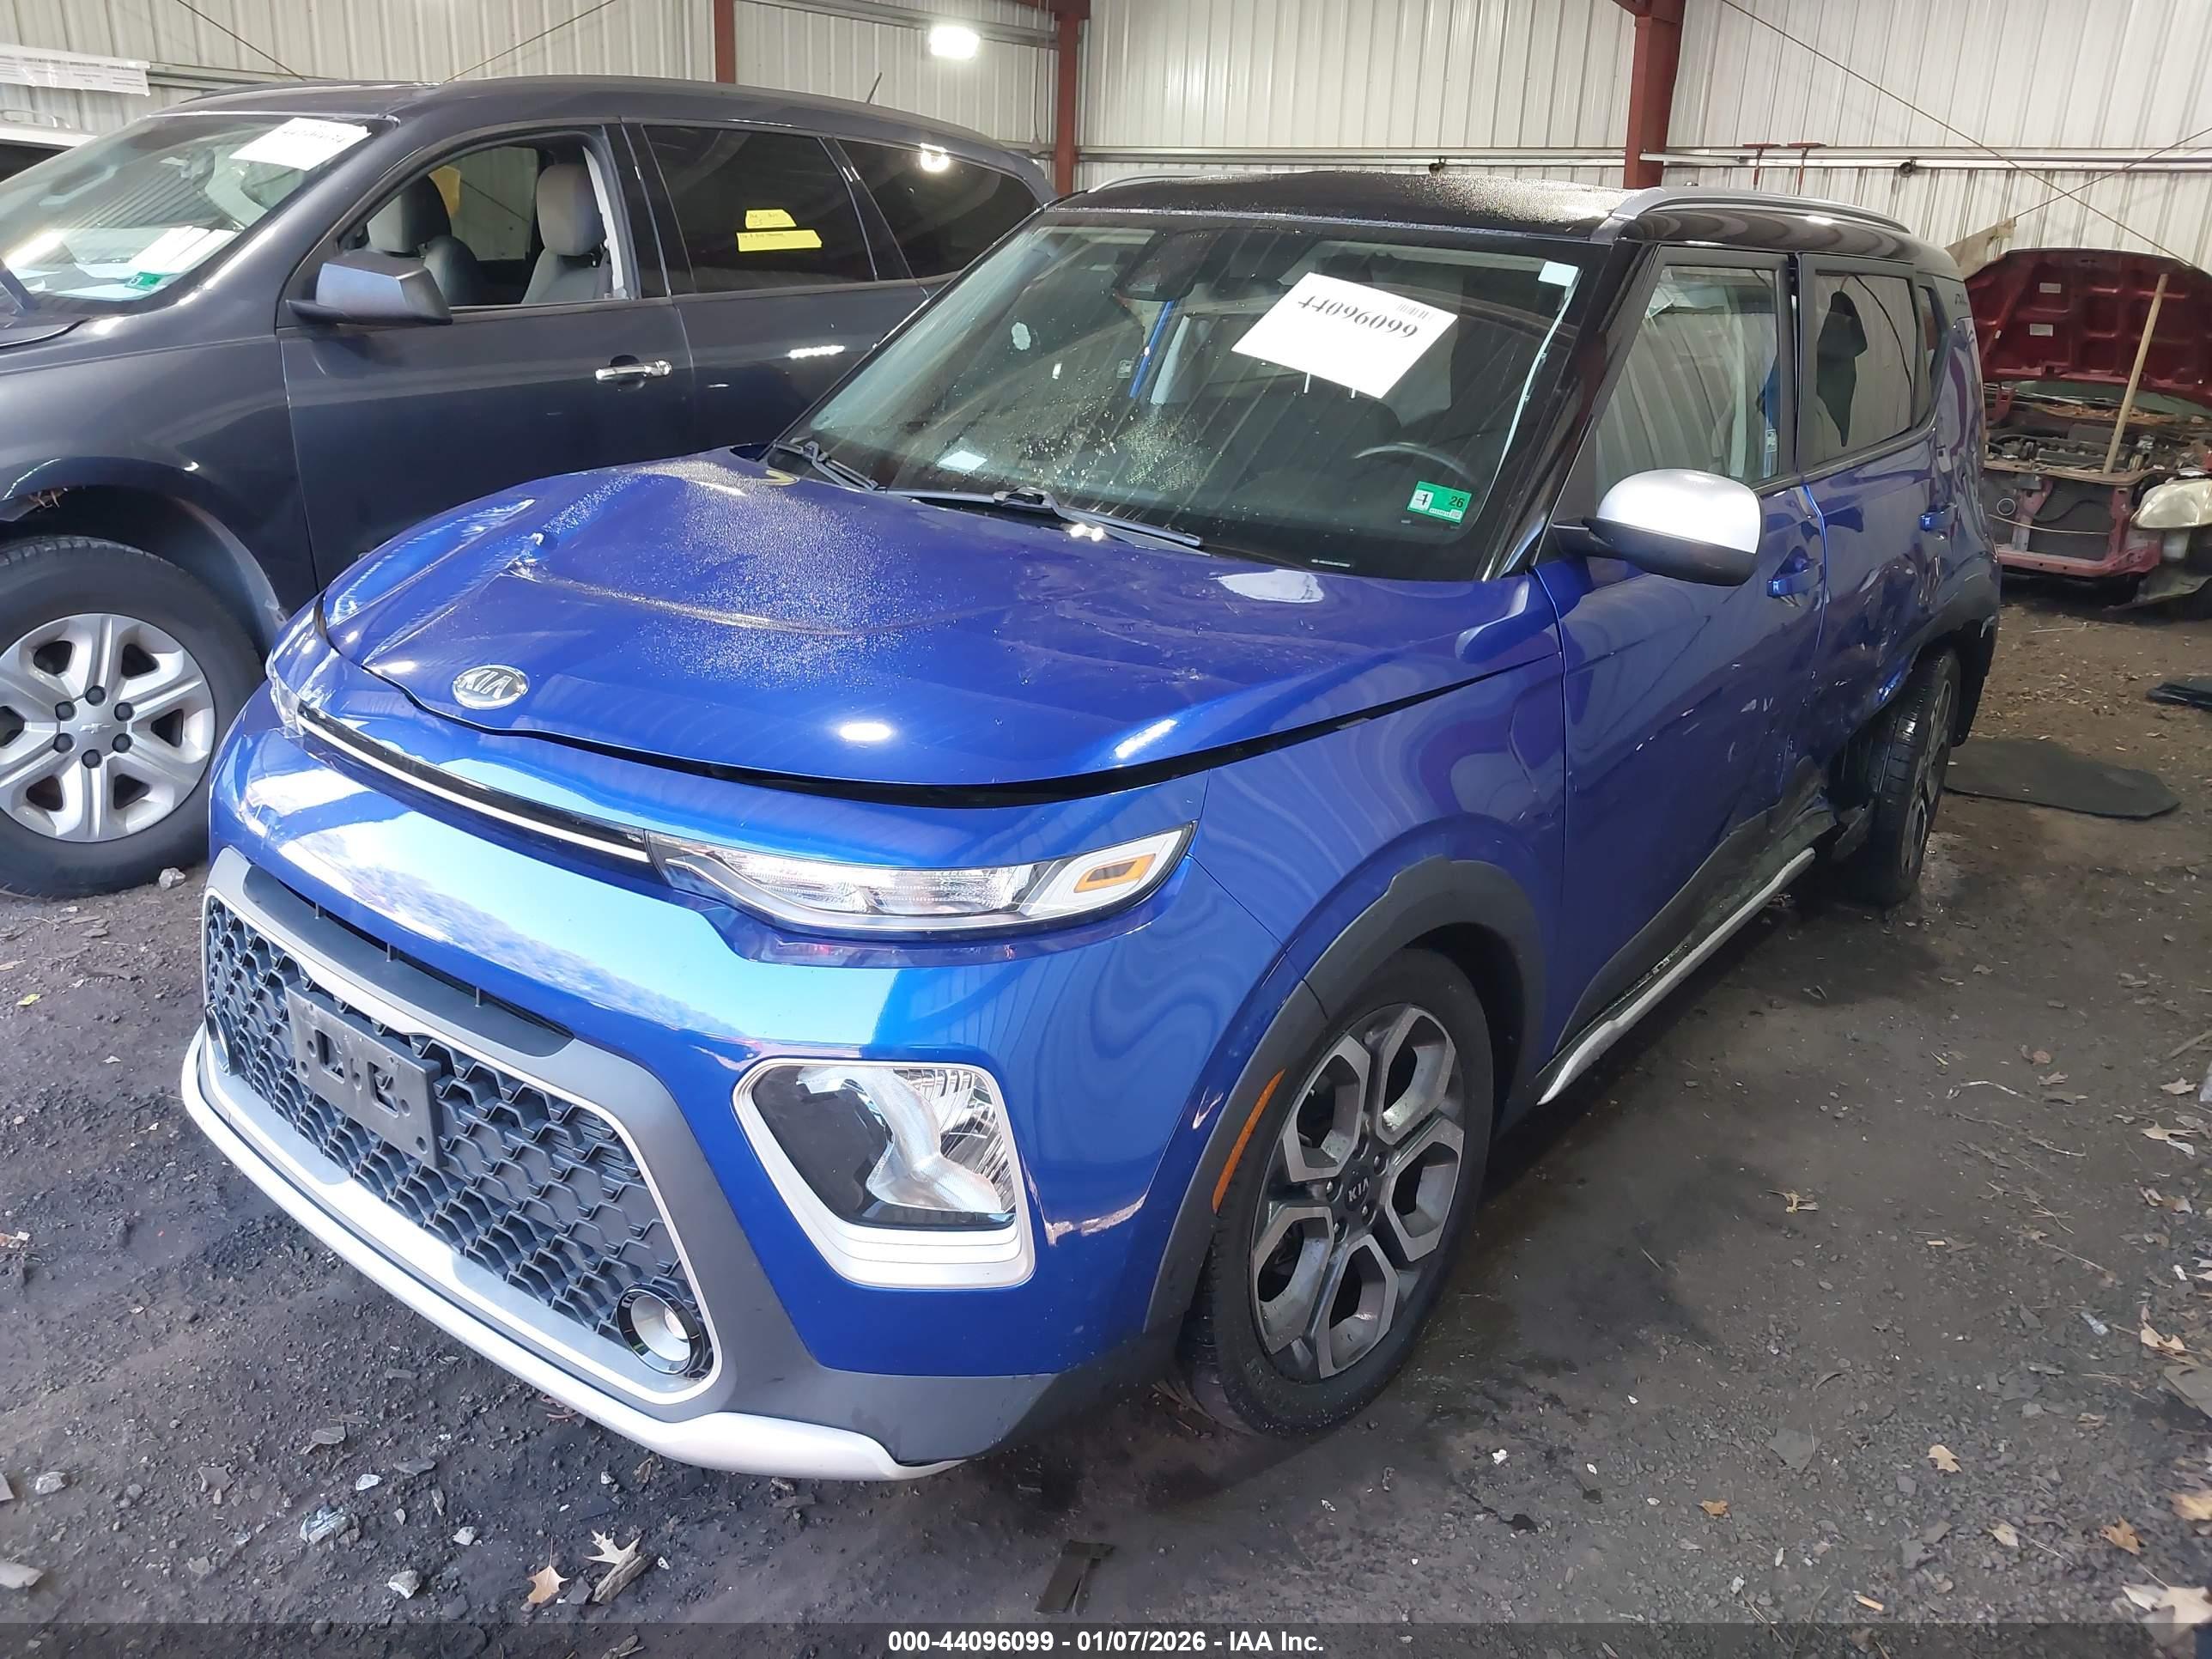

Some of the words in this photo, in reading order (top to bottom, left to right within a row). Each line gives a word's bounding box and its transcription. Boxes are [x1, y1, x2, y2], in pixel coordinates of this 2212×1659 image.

[1297, 295, 1419, 338] 44096099
[1449, 495, 1465, 508] 26
[457, 669, 514, 700] KIA
[1347, 1177, 1370, 1202] KIA
